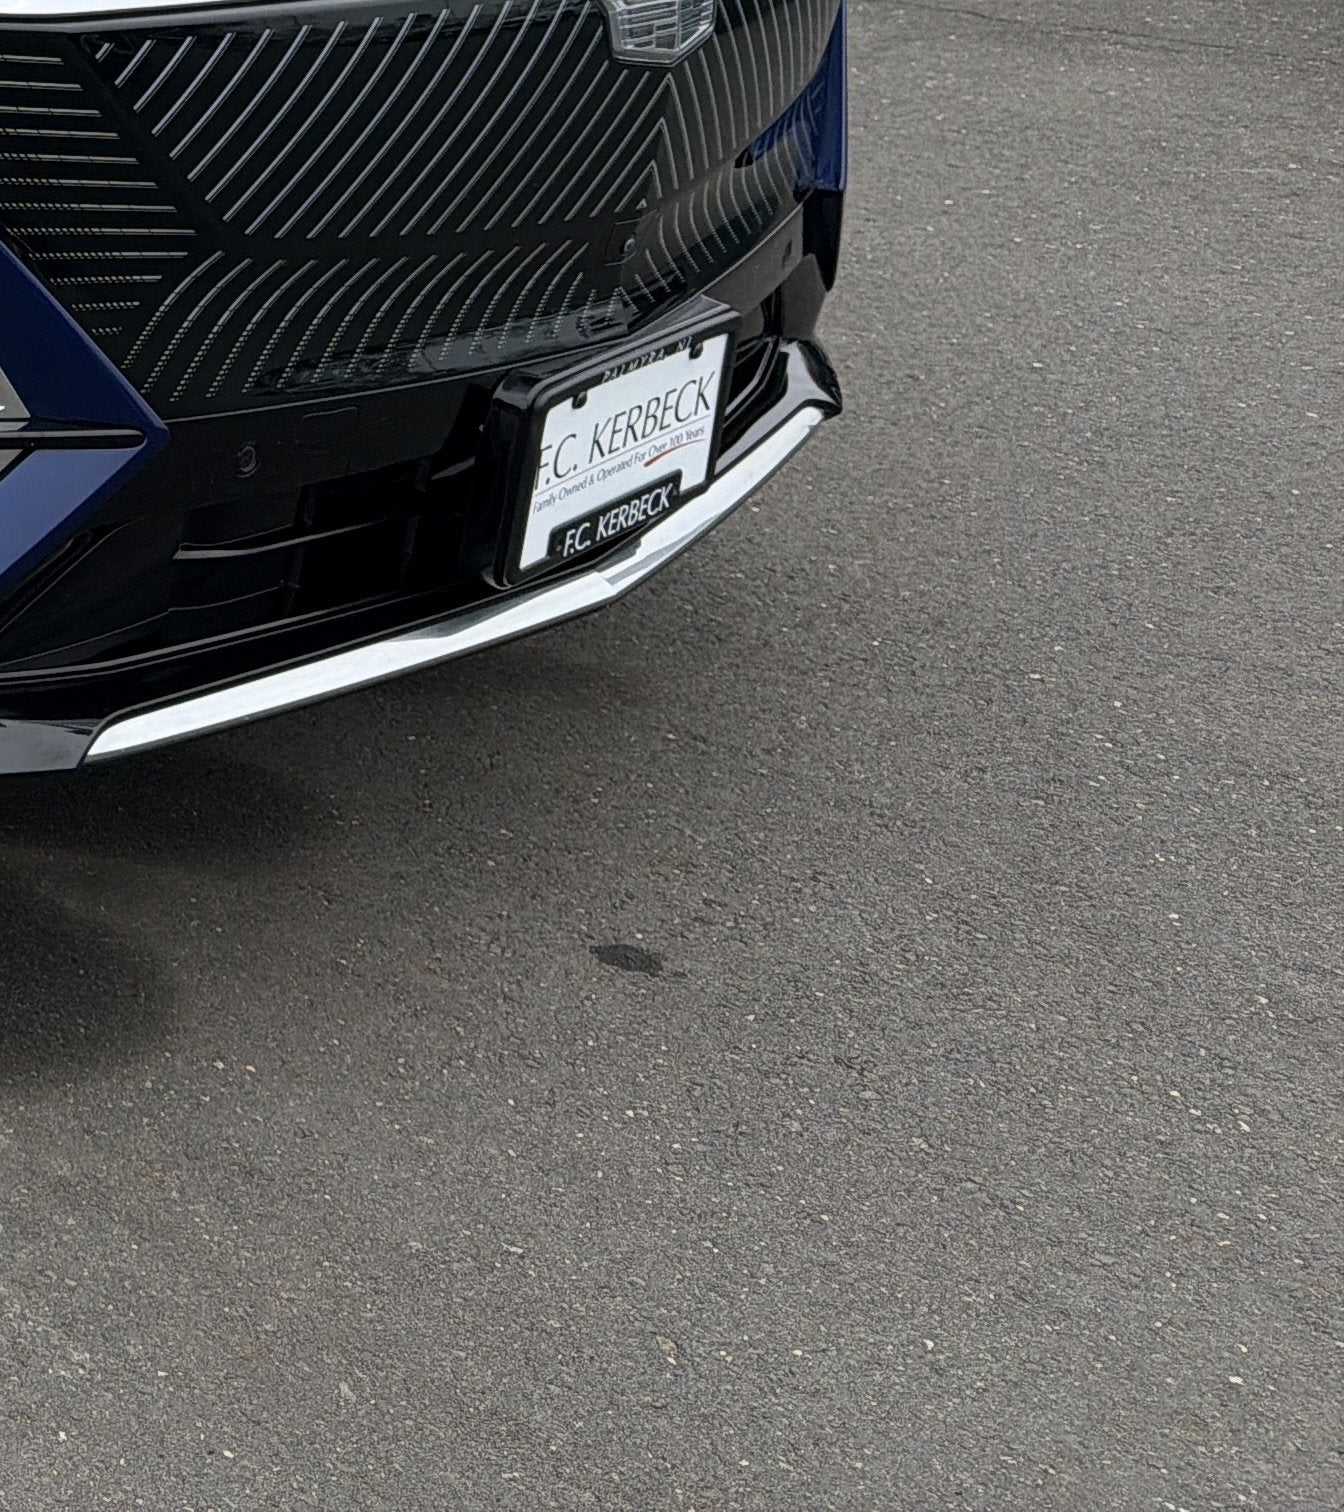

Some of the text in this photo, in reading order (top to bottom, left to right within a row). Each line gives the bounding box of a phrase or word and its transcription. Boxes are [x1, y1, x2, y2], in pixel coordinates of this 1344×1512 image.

[588, 370, 716, 465] KERBECK
[532, 425, 705, 515] Family Owned & Operated For Over 100 Years
[563, 482, 674, 558] F.C. KERBECK
